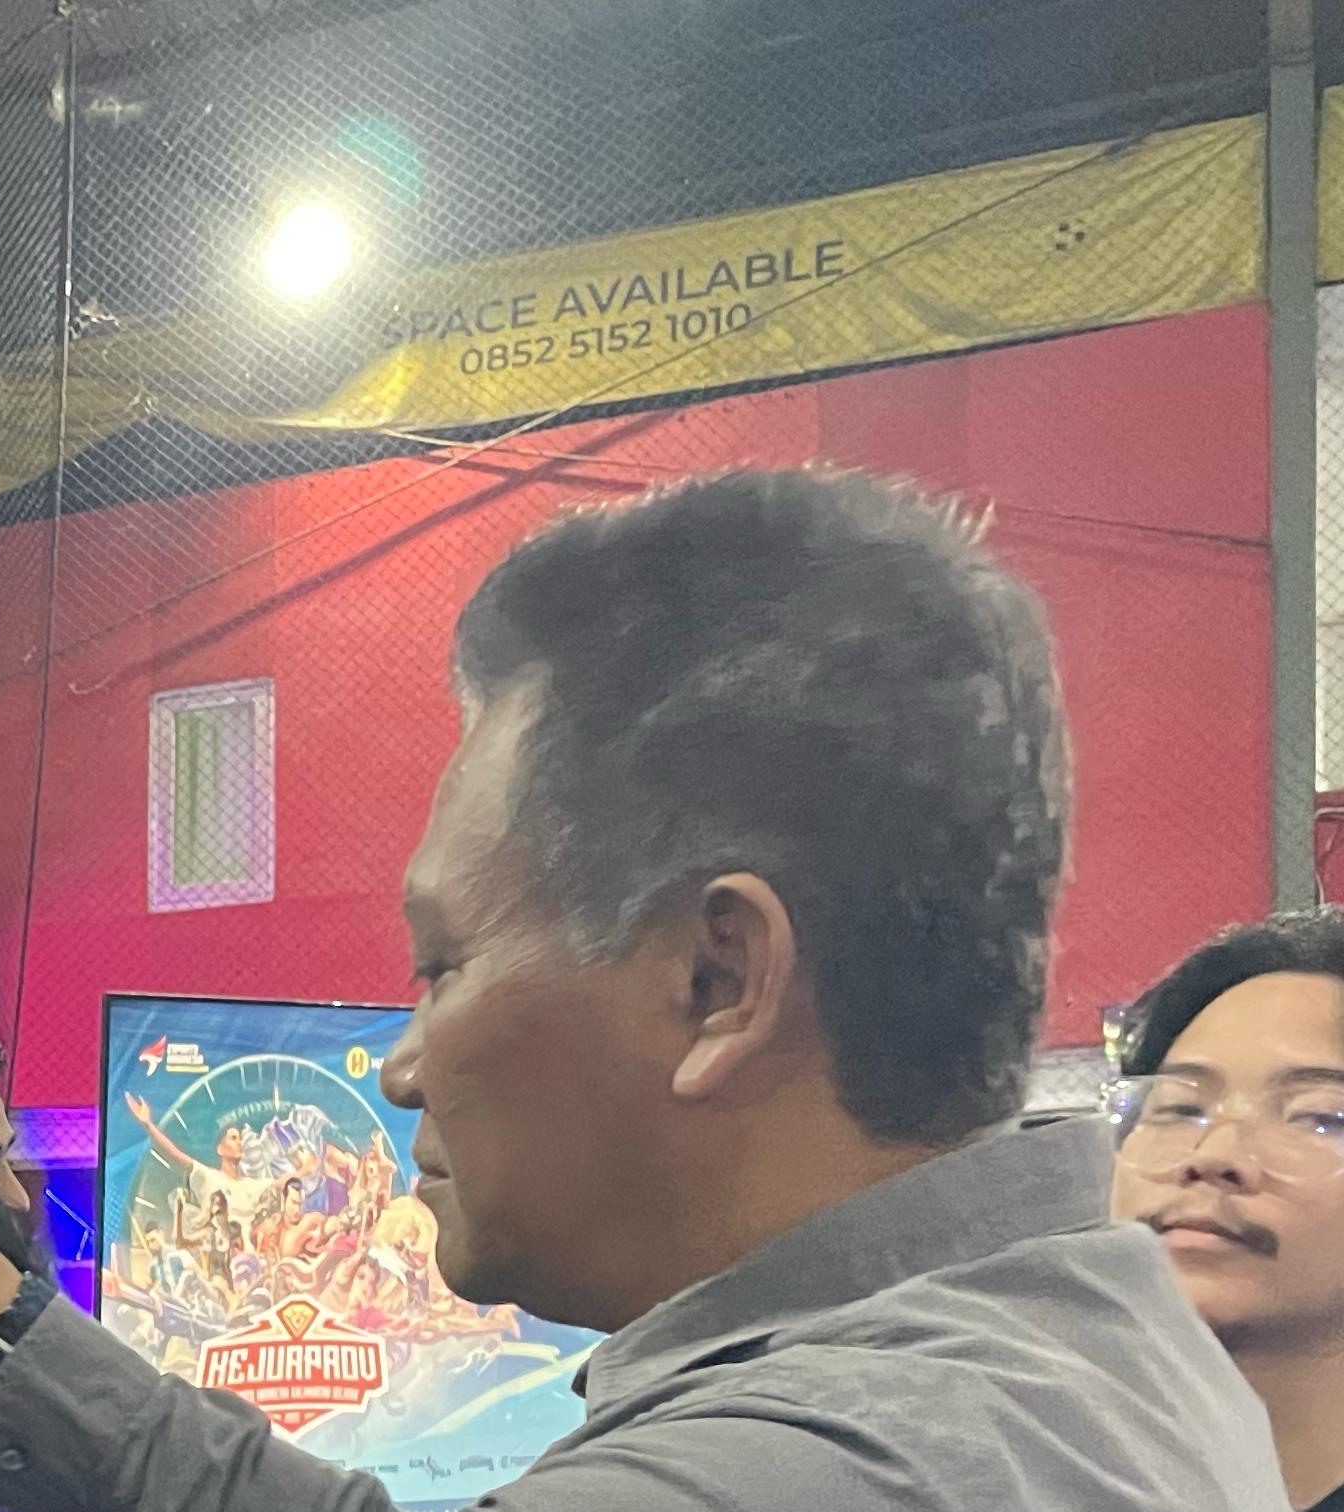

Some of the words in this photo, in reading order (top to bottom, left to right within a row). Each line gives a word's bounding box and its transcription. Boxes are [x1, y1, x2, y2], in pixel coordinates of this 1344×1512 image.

[382, 293, 538, 345] SPACE
[553, 240, 845, 322] AVAILABLE
[460, 336, 556, 375] 0852
[568, 320, 653, 359] 5152
[667, 303, 753, 343] 1010
